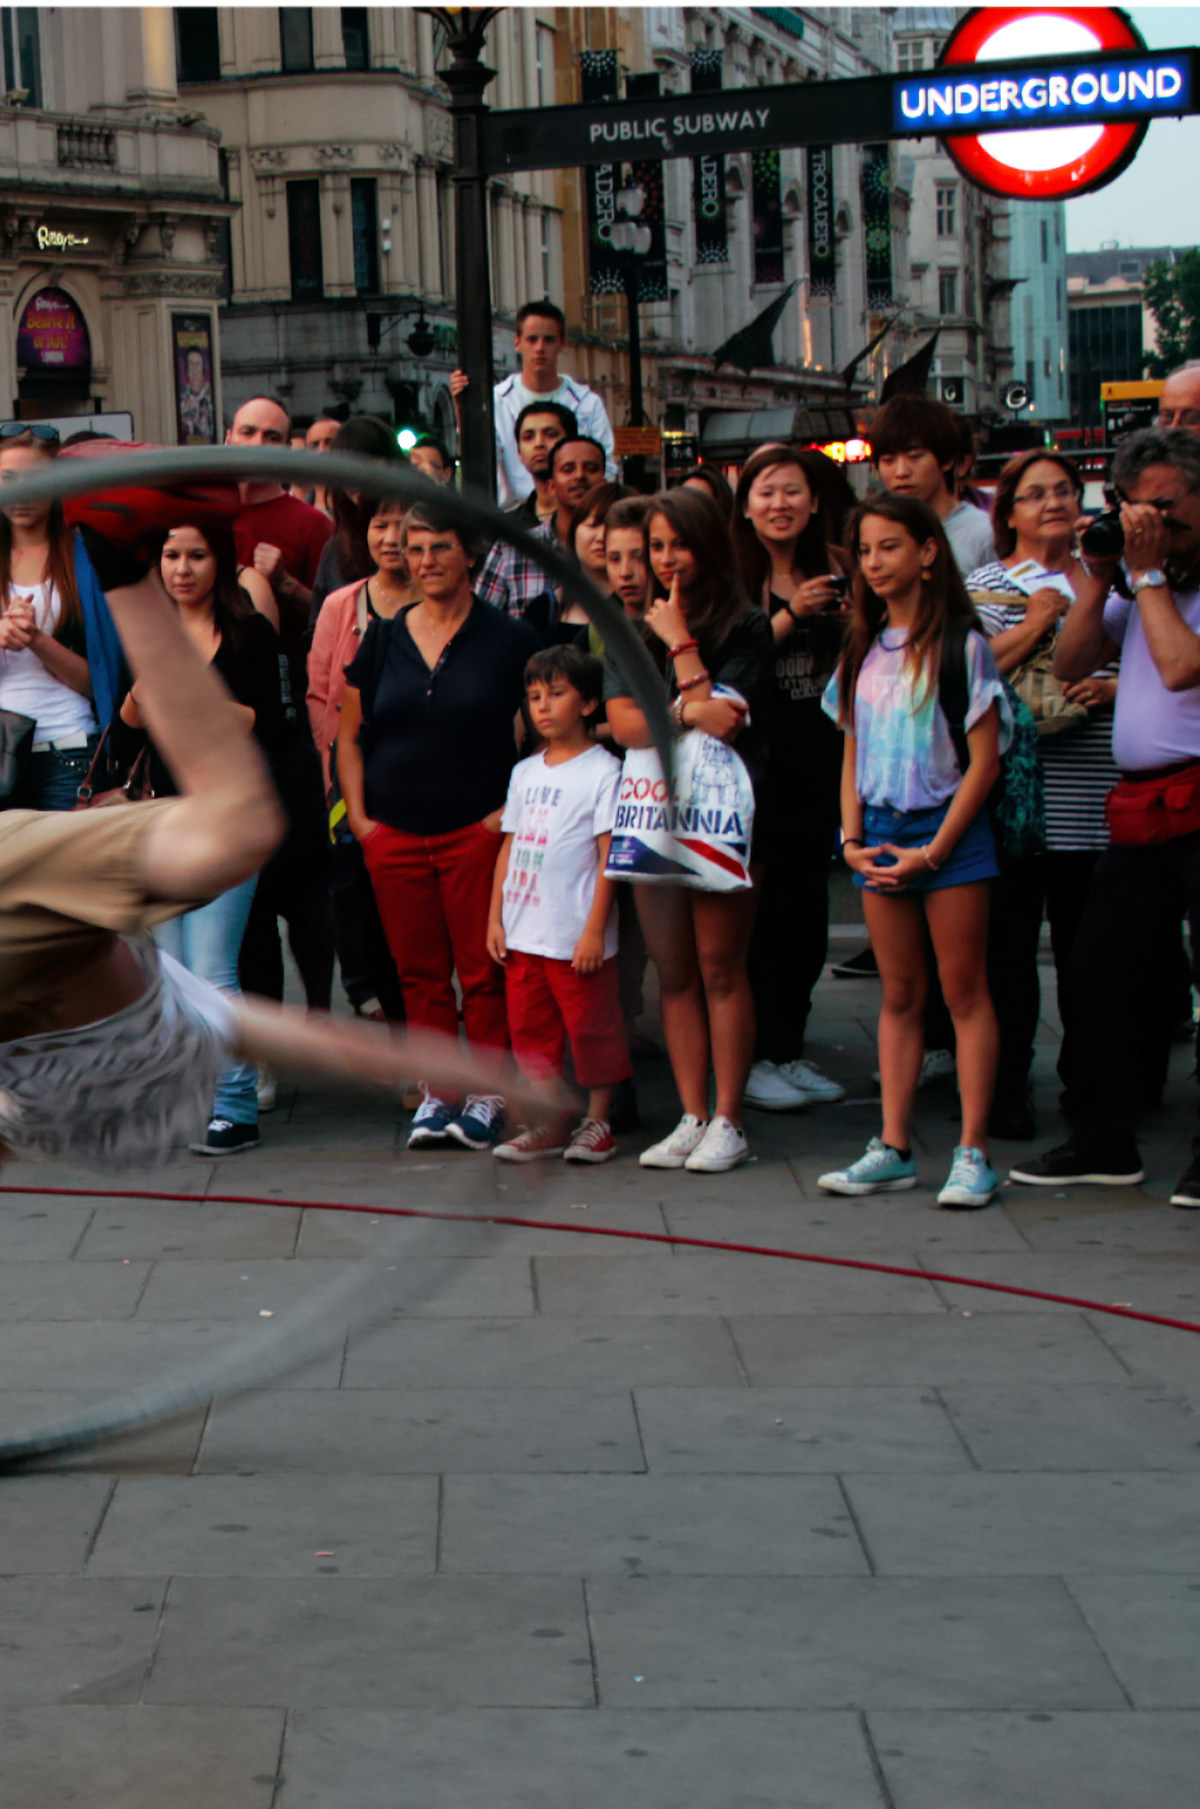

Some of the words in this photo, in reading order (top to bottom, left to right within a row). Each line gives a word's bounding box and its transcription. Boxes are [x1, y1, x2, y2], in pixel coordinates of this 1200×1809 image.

[900, 66, 1182, 119] UNDERGROUND
[589, 116, 668, 144] PUBLIC
[672, 107, 771, 136] SUBWAY
[595, 163, 615, 240] ADERO
[812, 150, 830, 257] TROCADERO
[27, 311, 63, 329] Believe
[524, 786, 562, 808] LIVE
[614, 804, 744, 837] BRITANNIA
